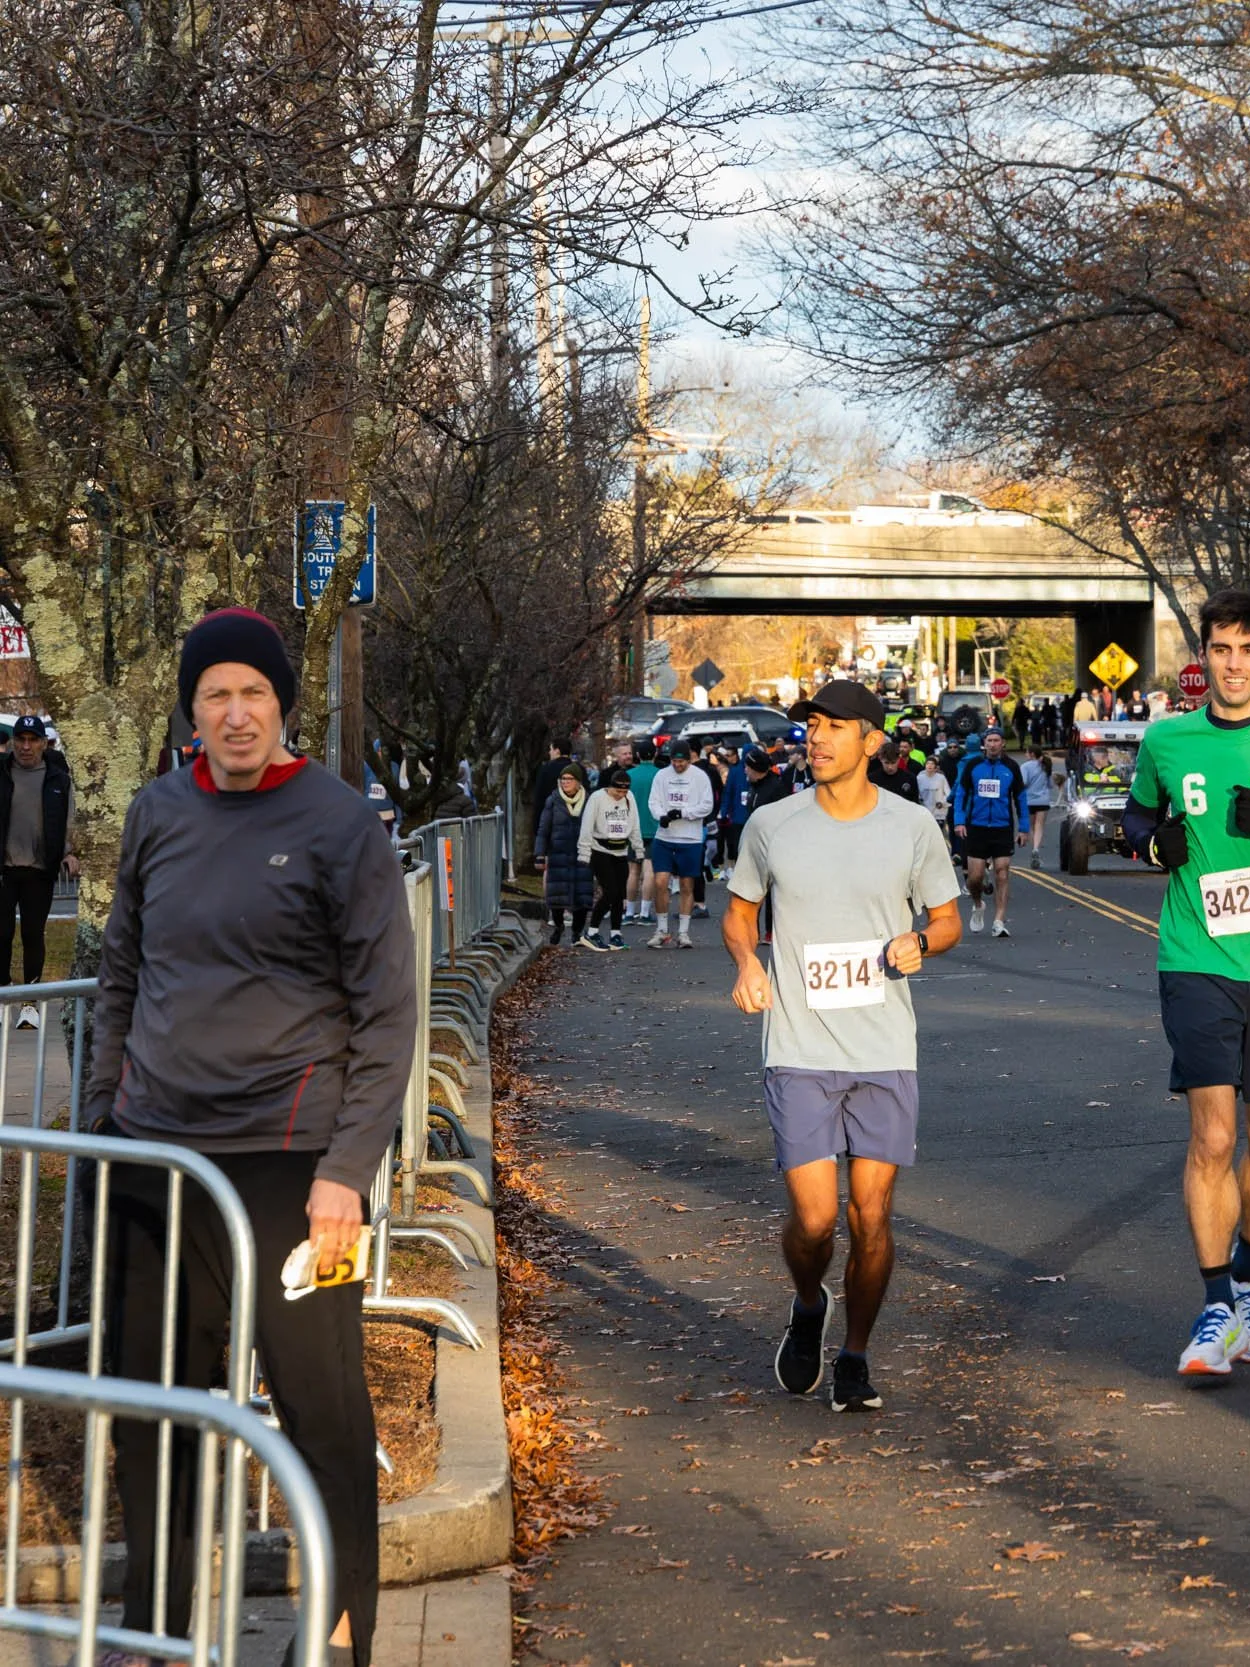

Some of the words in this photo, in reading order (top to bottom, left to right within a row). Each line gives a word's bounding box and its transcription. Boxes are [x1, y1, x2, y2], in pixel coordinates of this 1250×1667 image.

[0, 625, 24, 654] ET
[991, 684, 1009, 693] STOP
[1182, 772, 1208, 816] 6
[807, 958, 871, 990] 3214
